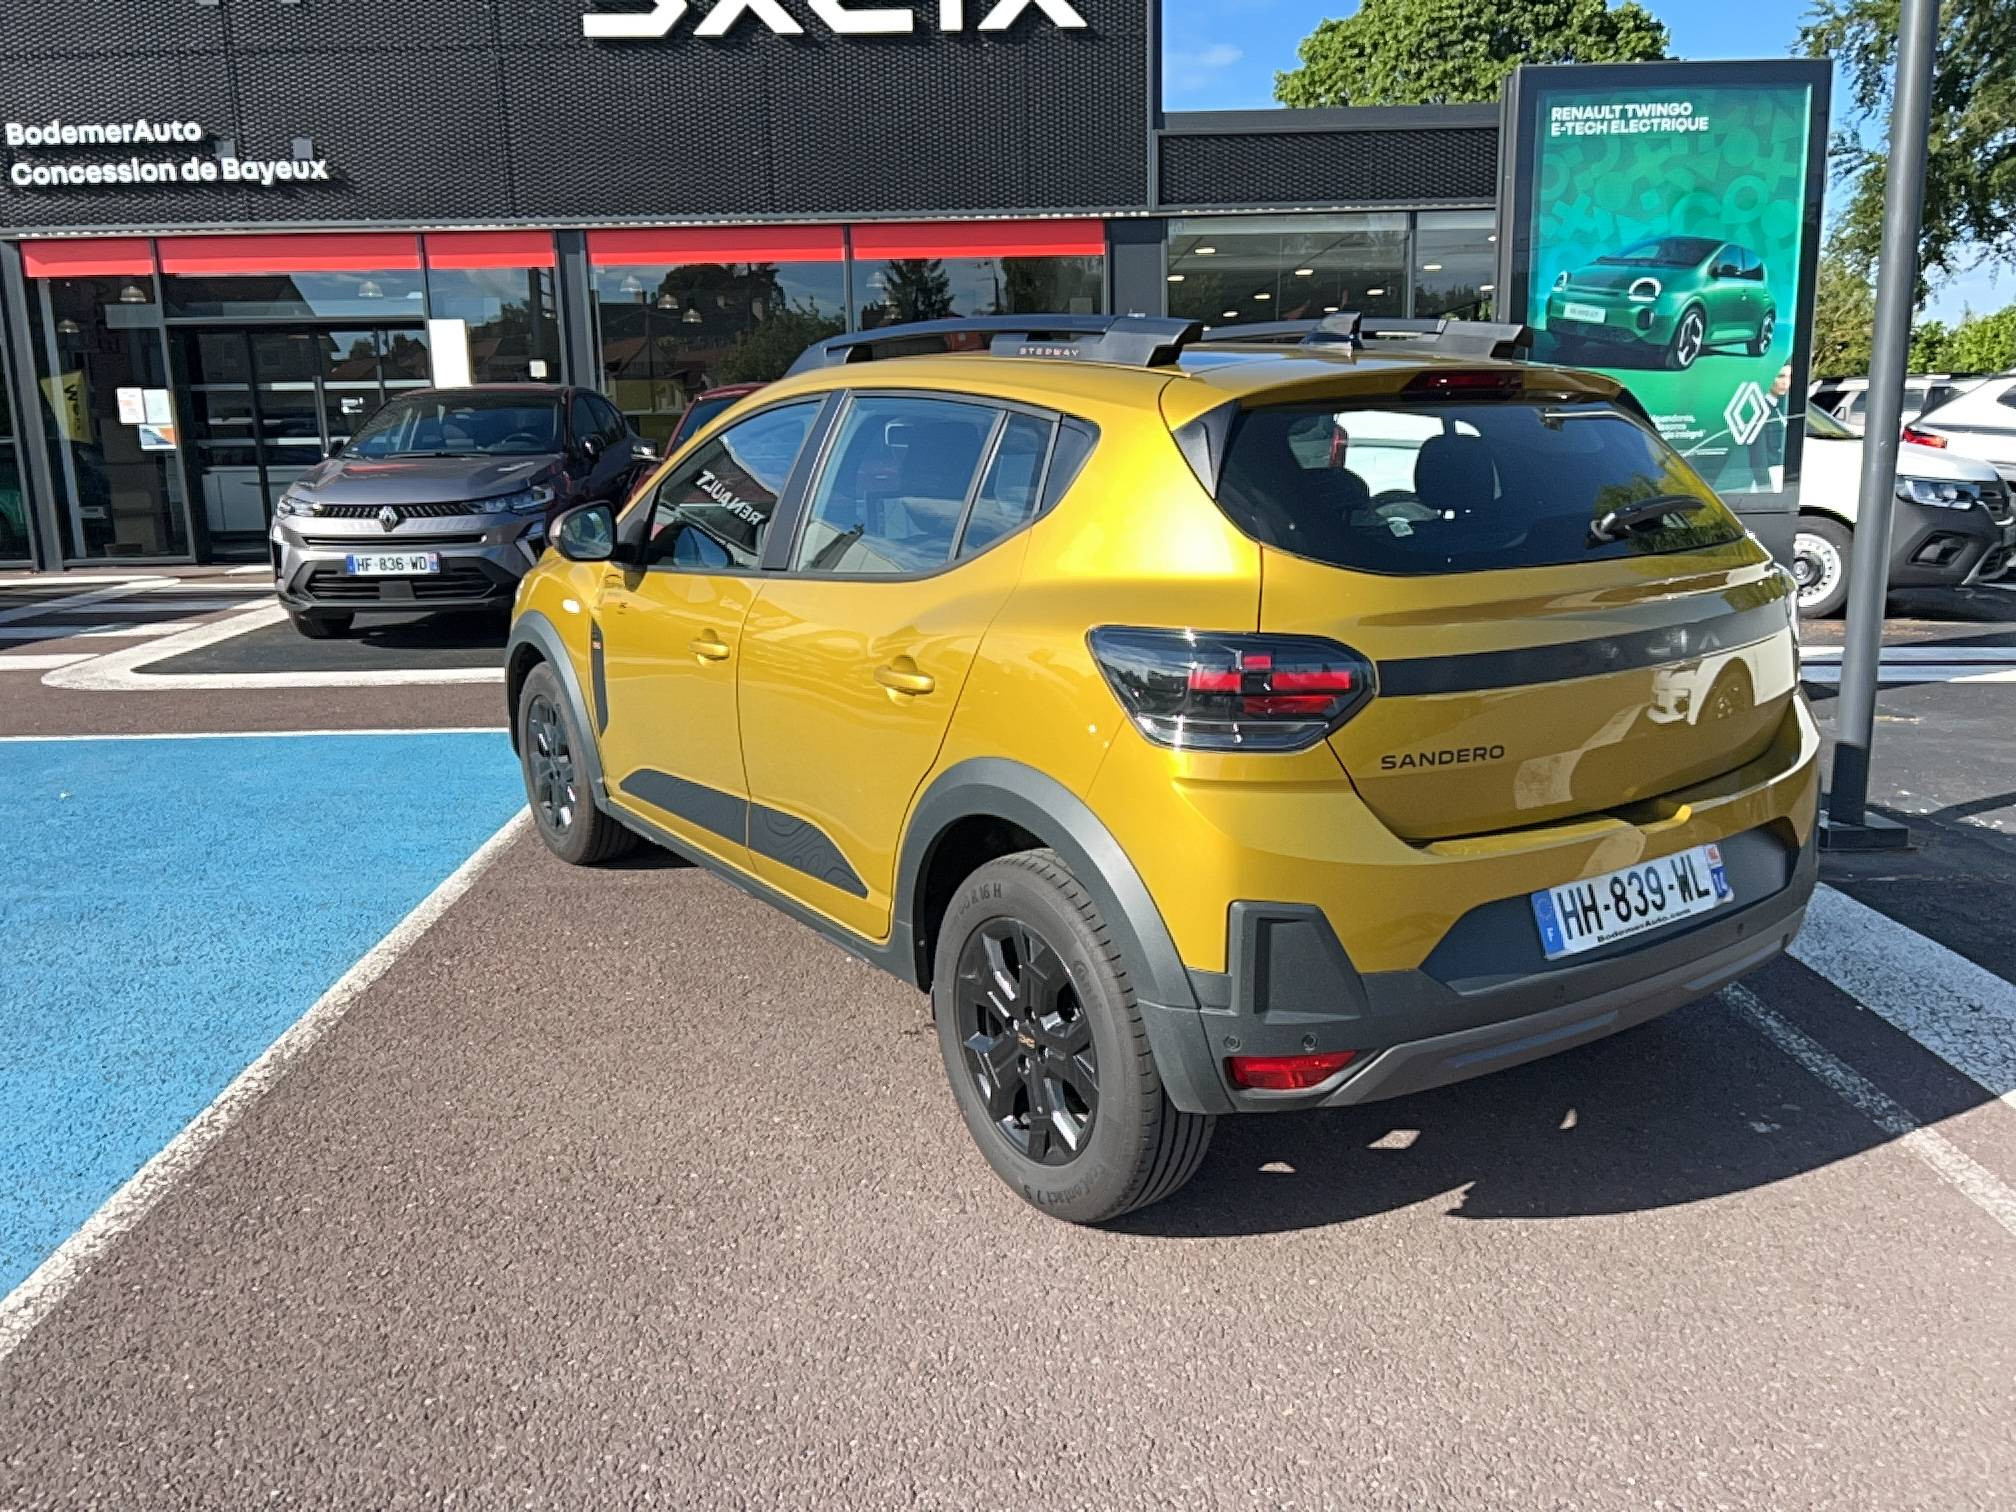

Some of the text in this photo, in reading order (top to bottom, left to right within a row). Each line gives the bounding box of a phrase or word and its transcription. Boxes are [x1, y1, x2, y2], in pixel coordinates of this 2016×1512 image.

[1551, 101, 1693, 121] RENAULT TWINGO
[5, 119, 203, 146] BodemerAuto
[1551, 117, 1709, 137] E-TECH ELECTRIQUE
[10, 157, 330, 187] Concession de Bayeux
[1018, 347, 1080, 357] STEPWAY
[1381, 744, 1506, 770] SANDERO
[1557, 854, 1710, 940] HH-839-WL
